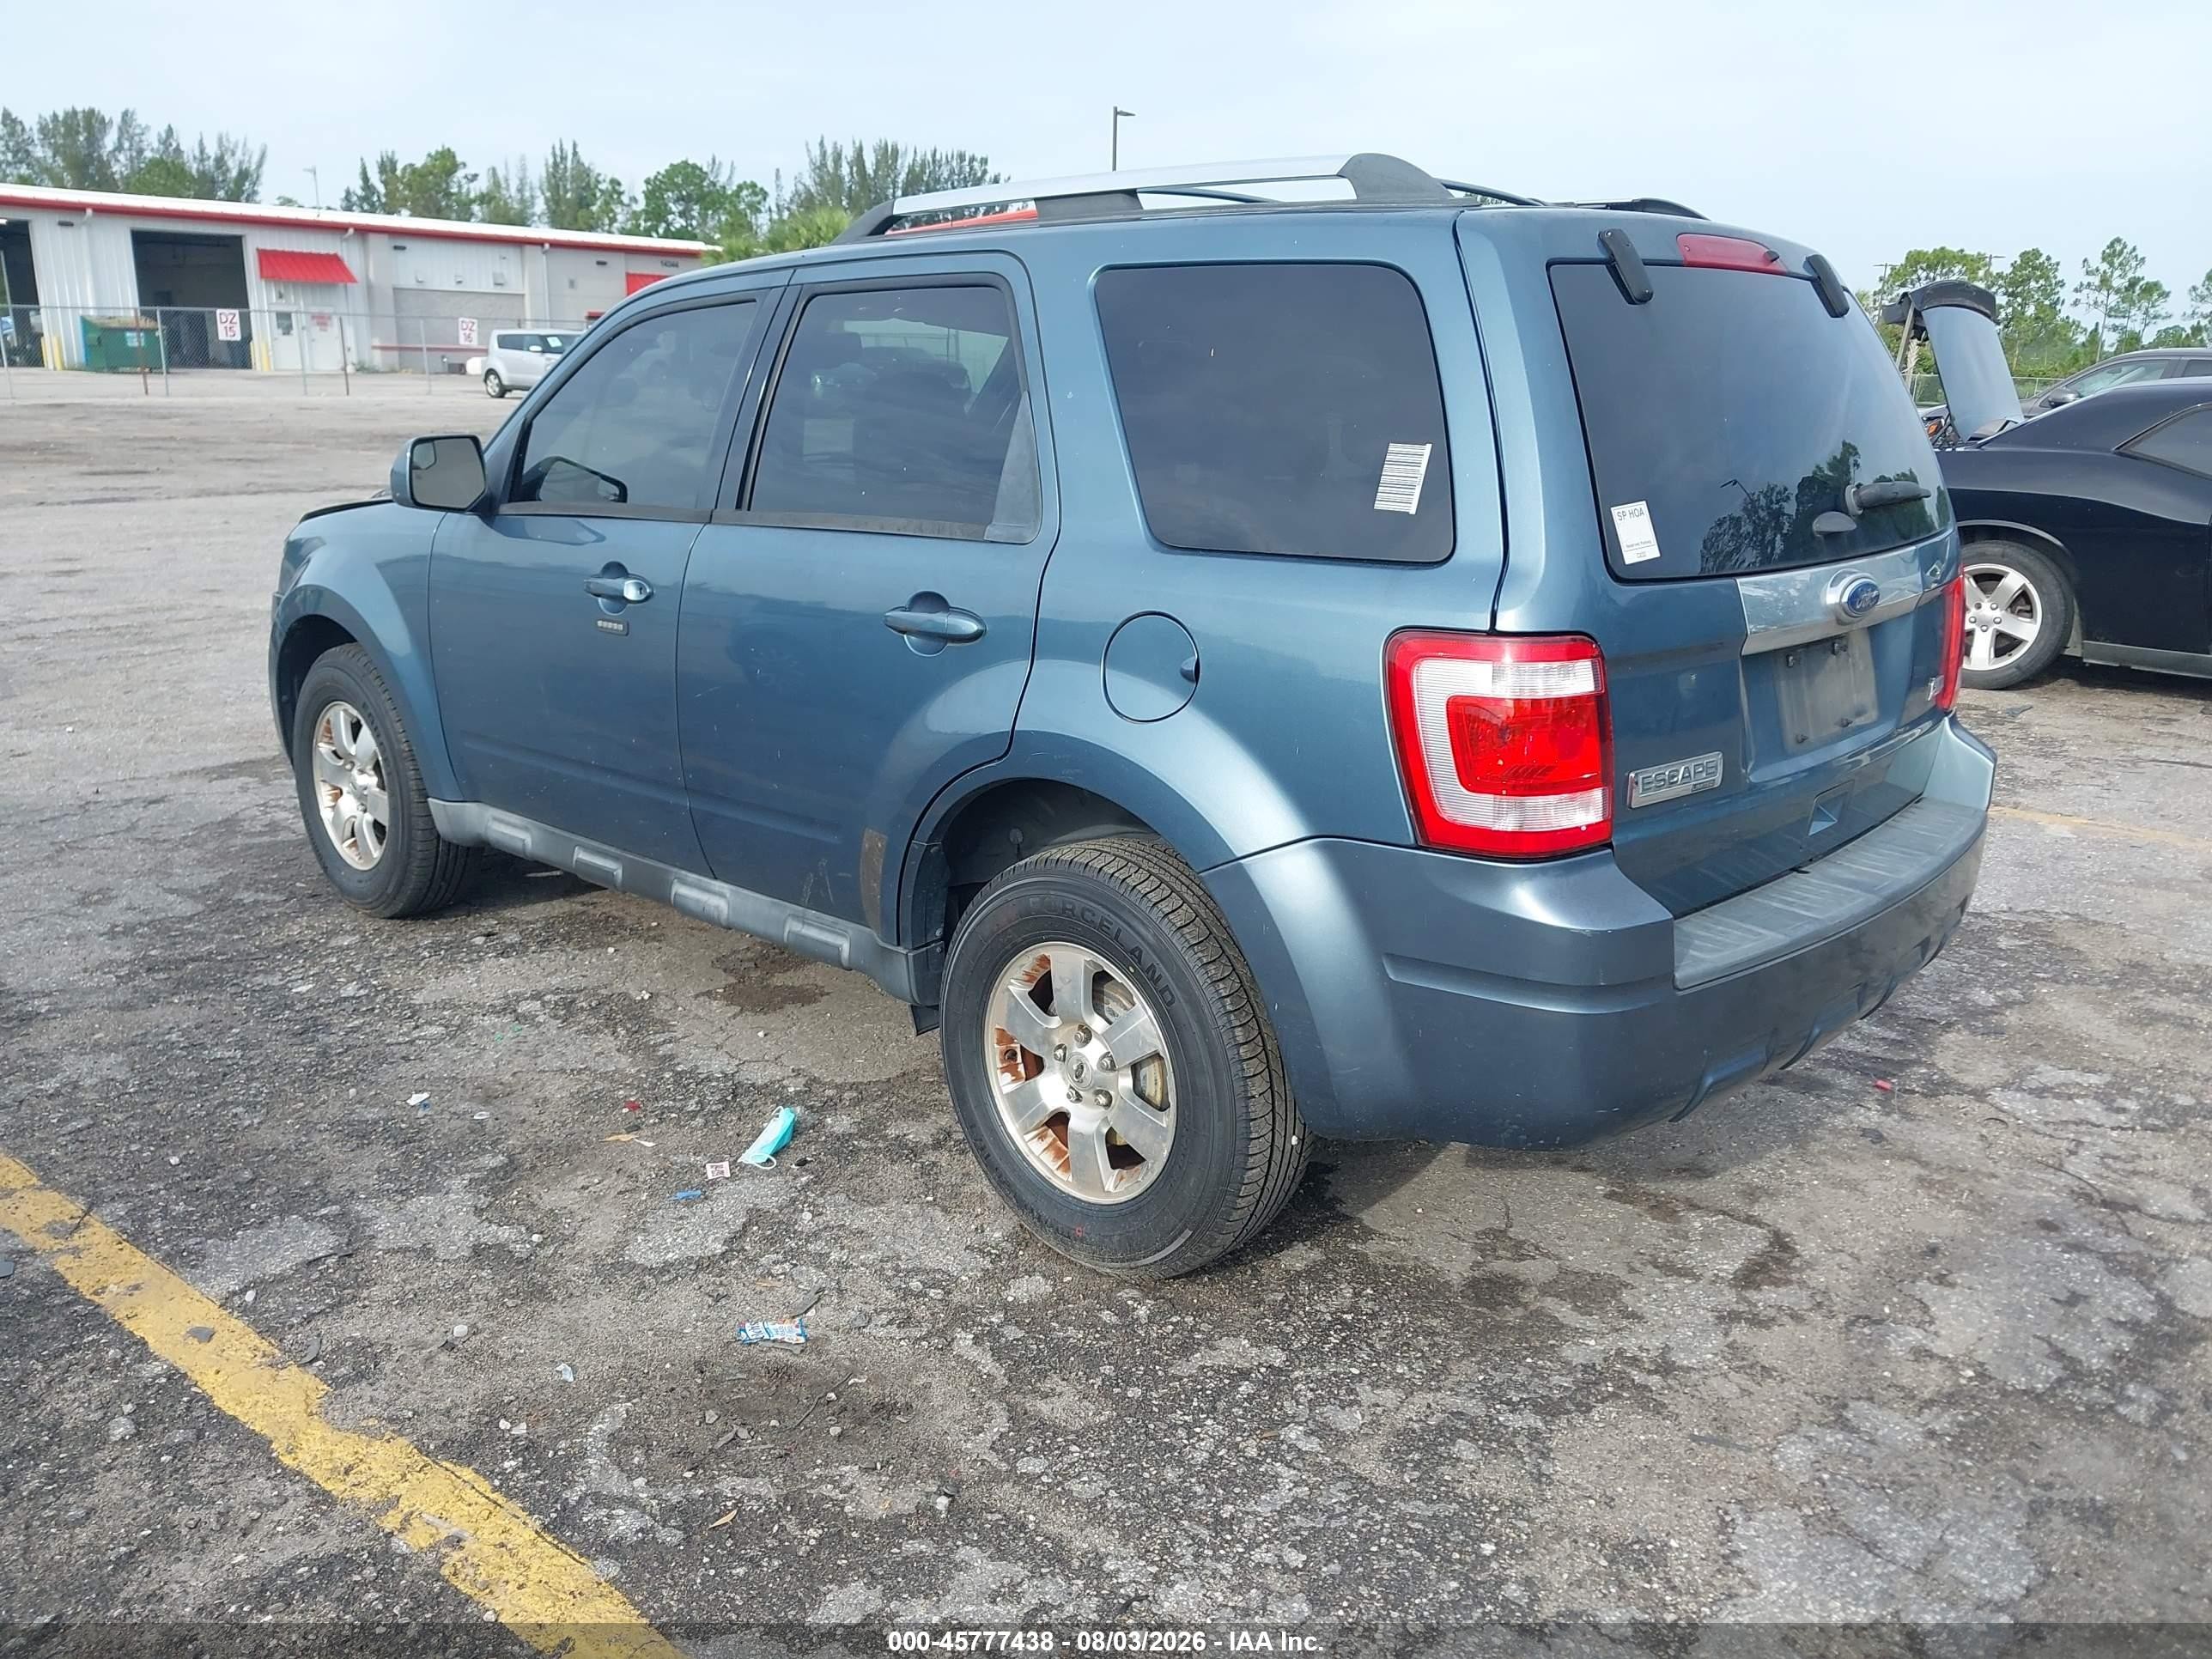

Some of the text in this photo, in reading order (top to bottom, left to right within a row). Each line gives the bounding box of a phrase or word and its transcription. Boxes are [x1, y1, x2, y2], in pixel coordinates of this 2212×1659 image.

[220, 313, 237, 324] DZ
[224, 326, 236, 337] 15
[1617, 507, 1644, 521] SP HOA
[1638, 758, 1718, 794] ESCAPE
[1030, 896, 1176, 1008] FORCELAND
